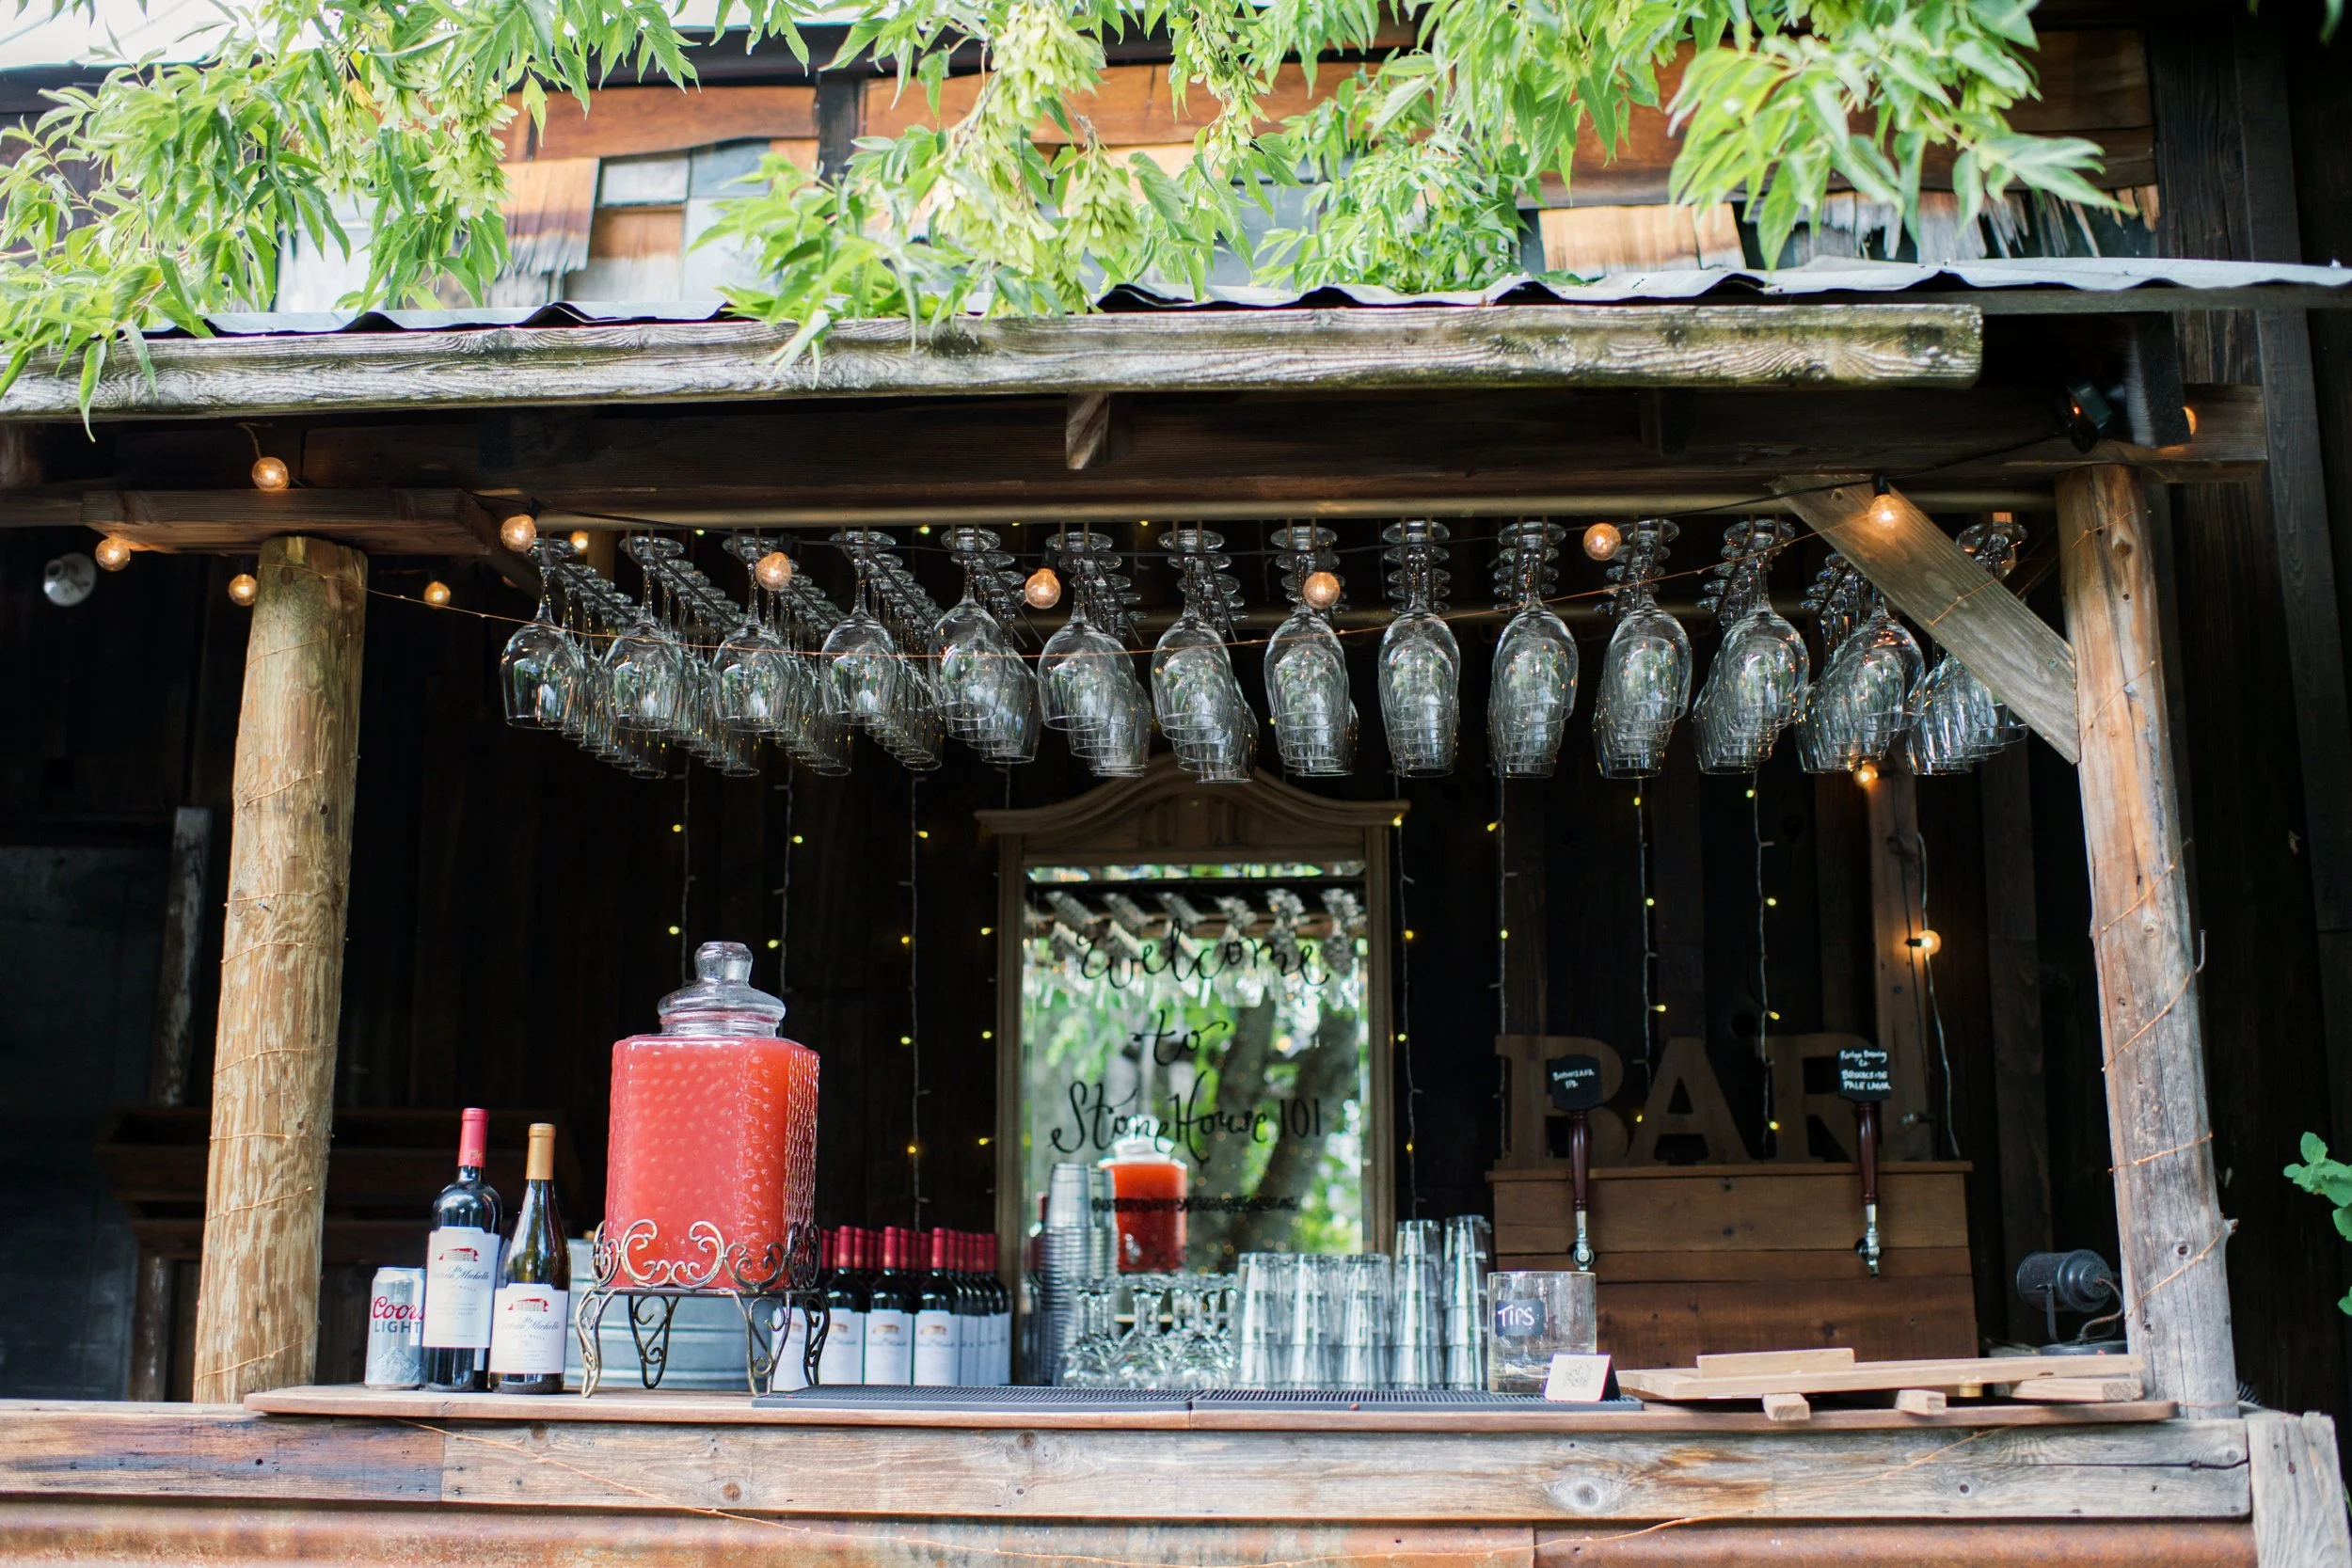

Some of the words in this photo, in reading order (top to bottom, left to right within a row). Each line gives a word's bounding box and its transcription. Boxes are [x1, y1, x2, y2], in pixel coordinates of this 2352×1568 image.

[1131, 1009, 1229, 1067] to
[1494, 1033, 1882, 1168] BAR
[1843, 1081, 1866, 1091] PALE
[1278, 1098, 1322, 1138] 101
[374, 1321, 421, 1334] LIGHT
